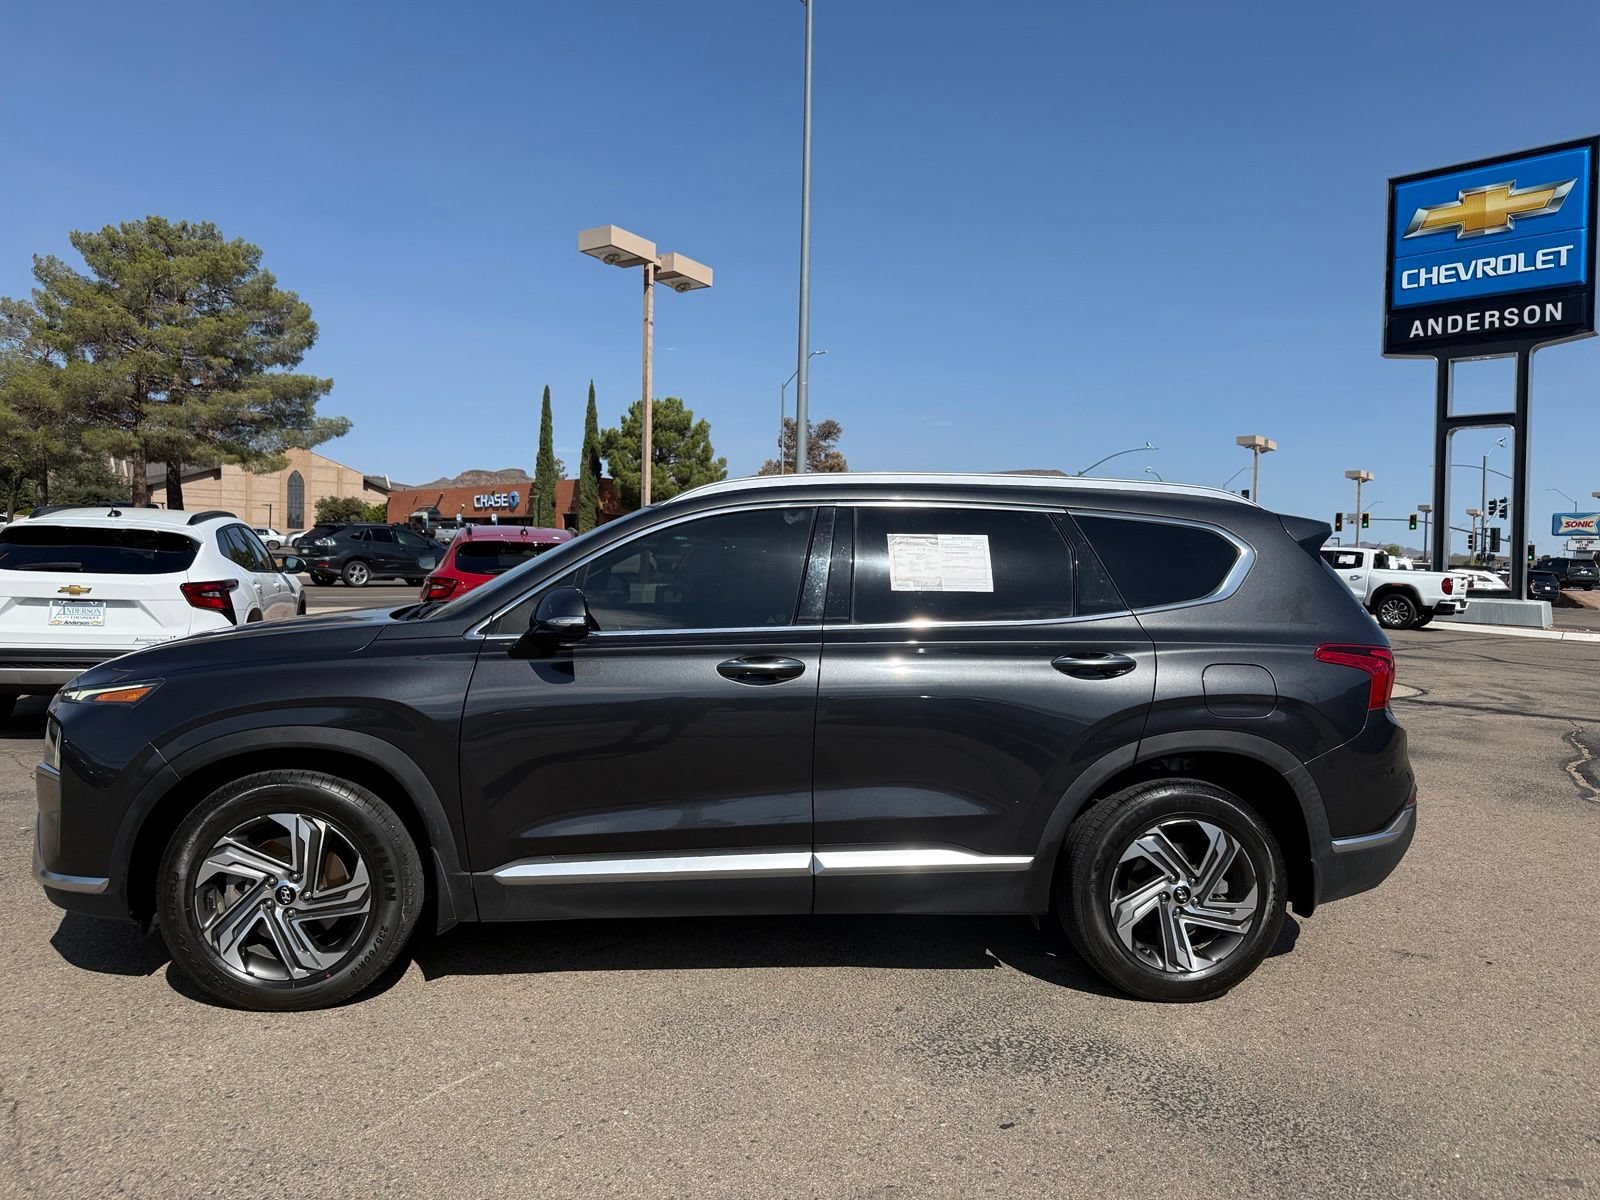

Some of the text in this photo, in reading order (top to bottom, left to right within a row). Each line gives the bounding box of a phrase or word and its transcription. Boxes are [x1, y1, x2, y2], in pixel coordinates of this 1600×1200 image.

[1401, 245, 1574, 290] CHEVROLET
[1409, 301, 1563, 338] ANDERSON
[473, 493, 509, 508] CHASE
[1564, 520, 1594, 528] SONIC
[54, 605, 101, 618] ANDERSON
[349, 925, 389, 978] 235/60R18
